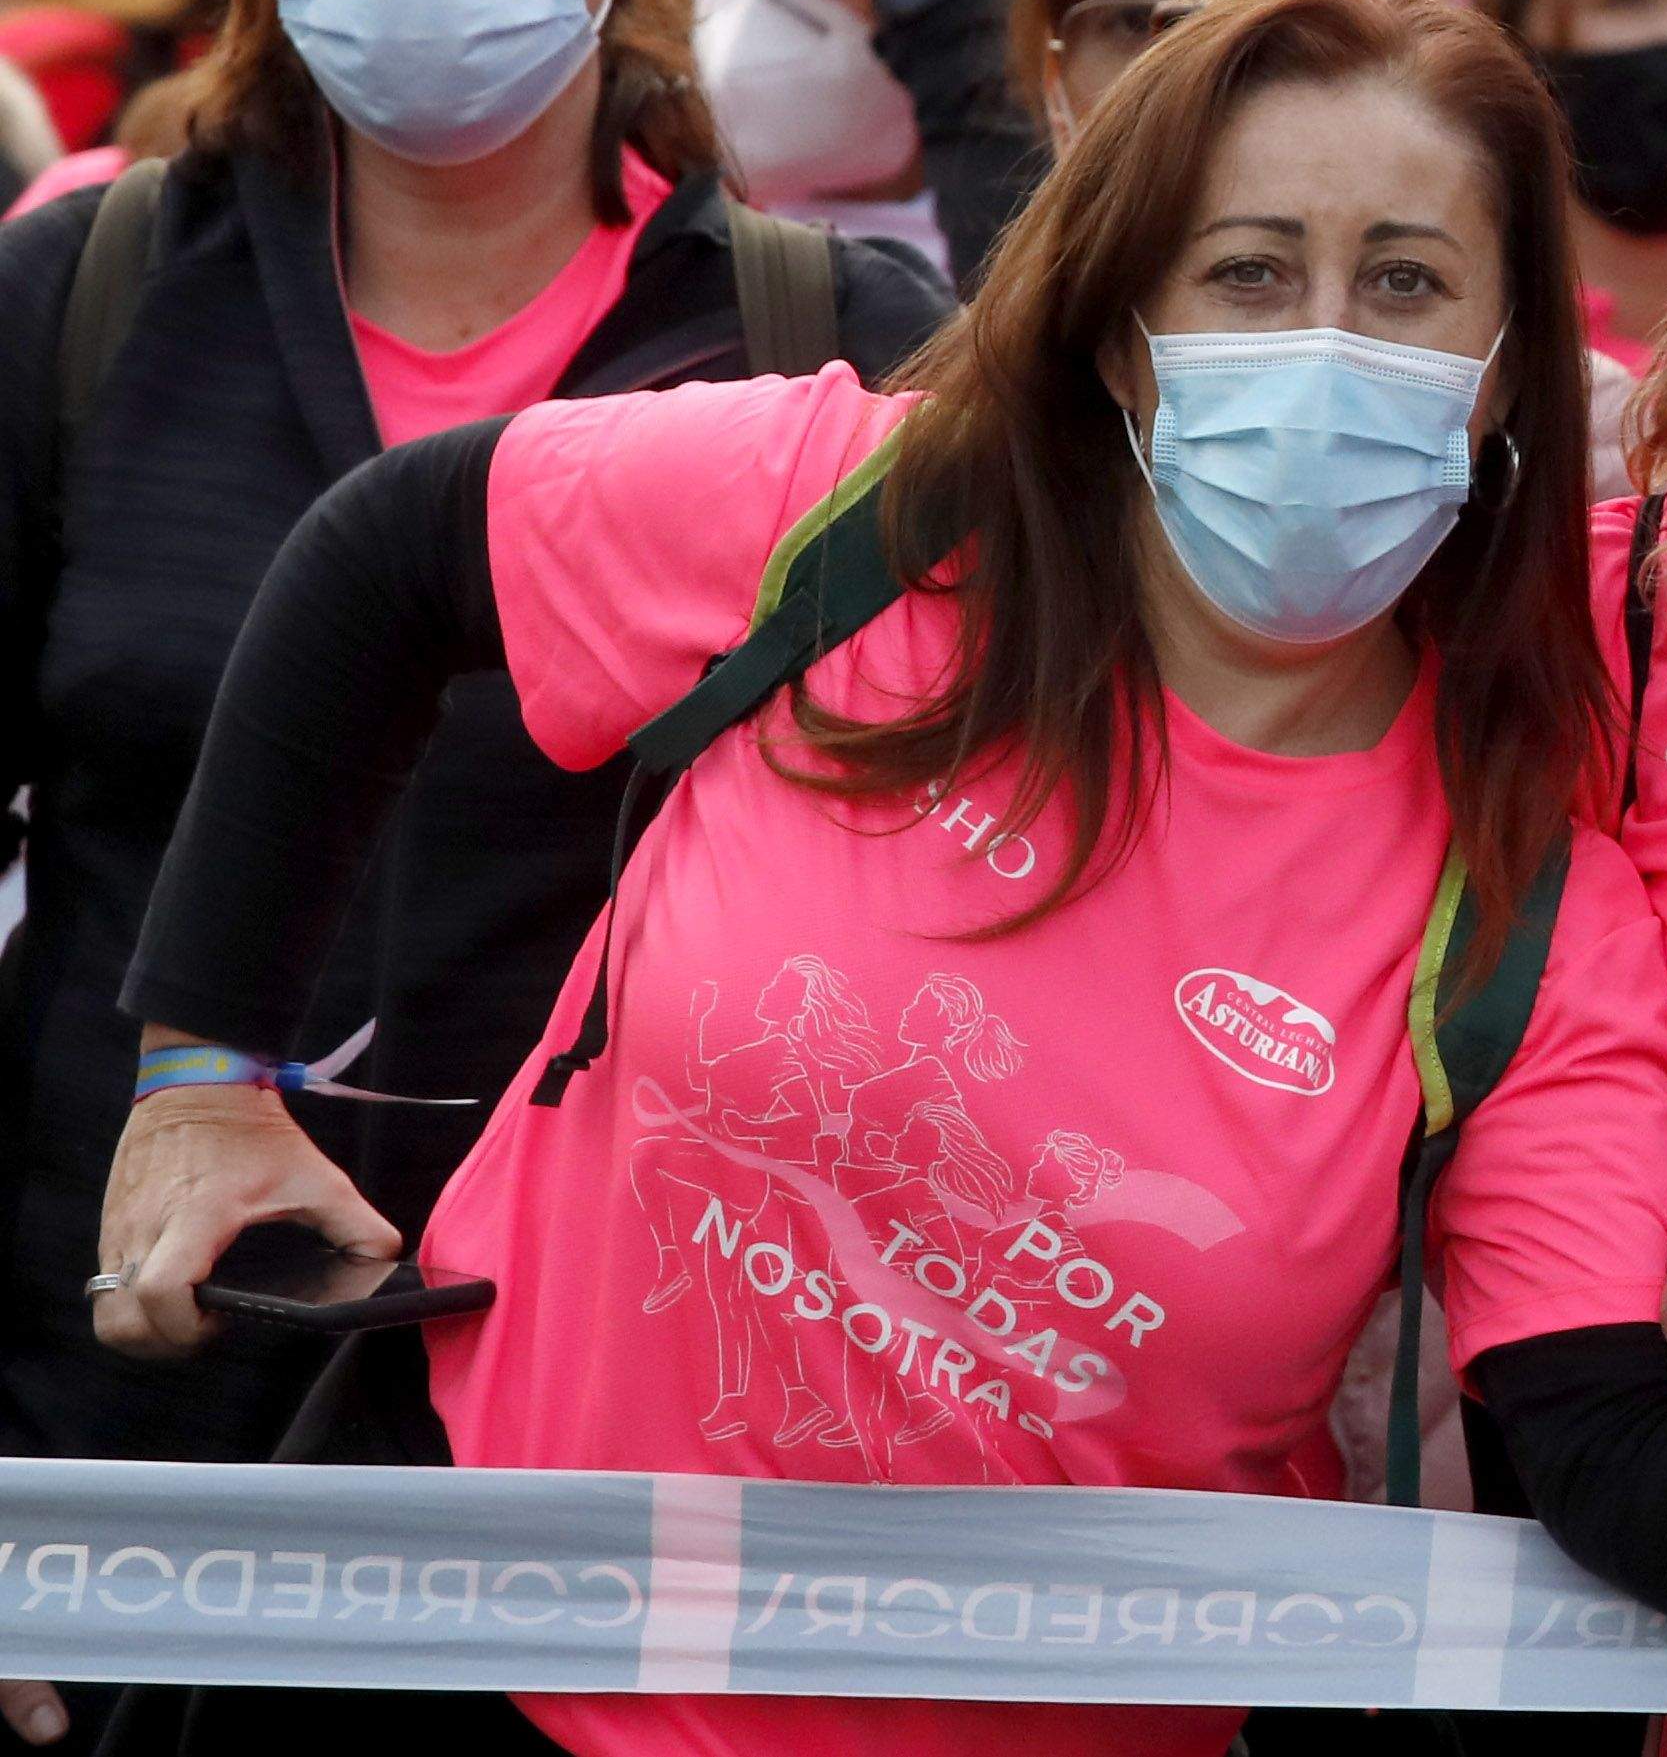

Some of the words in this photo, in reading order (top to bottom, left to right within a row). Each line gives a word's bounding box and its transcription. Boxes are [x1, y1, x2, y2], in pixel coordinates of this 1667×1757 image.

[913, 777, 1036, 879] SHO
[880, 1218, 1109, 1393] TODAS
[1003, 1219, 1166, 1348] POR
